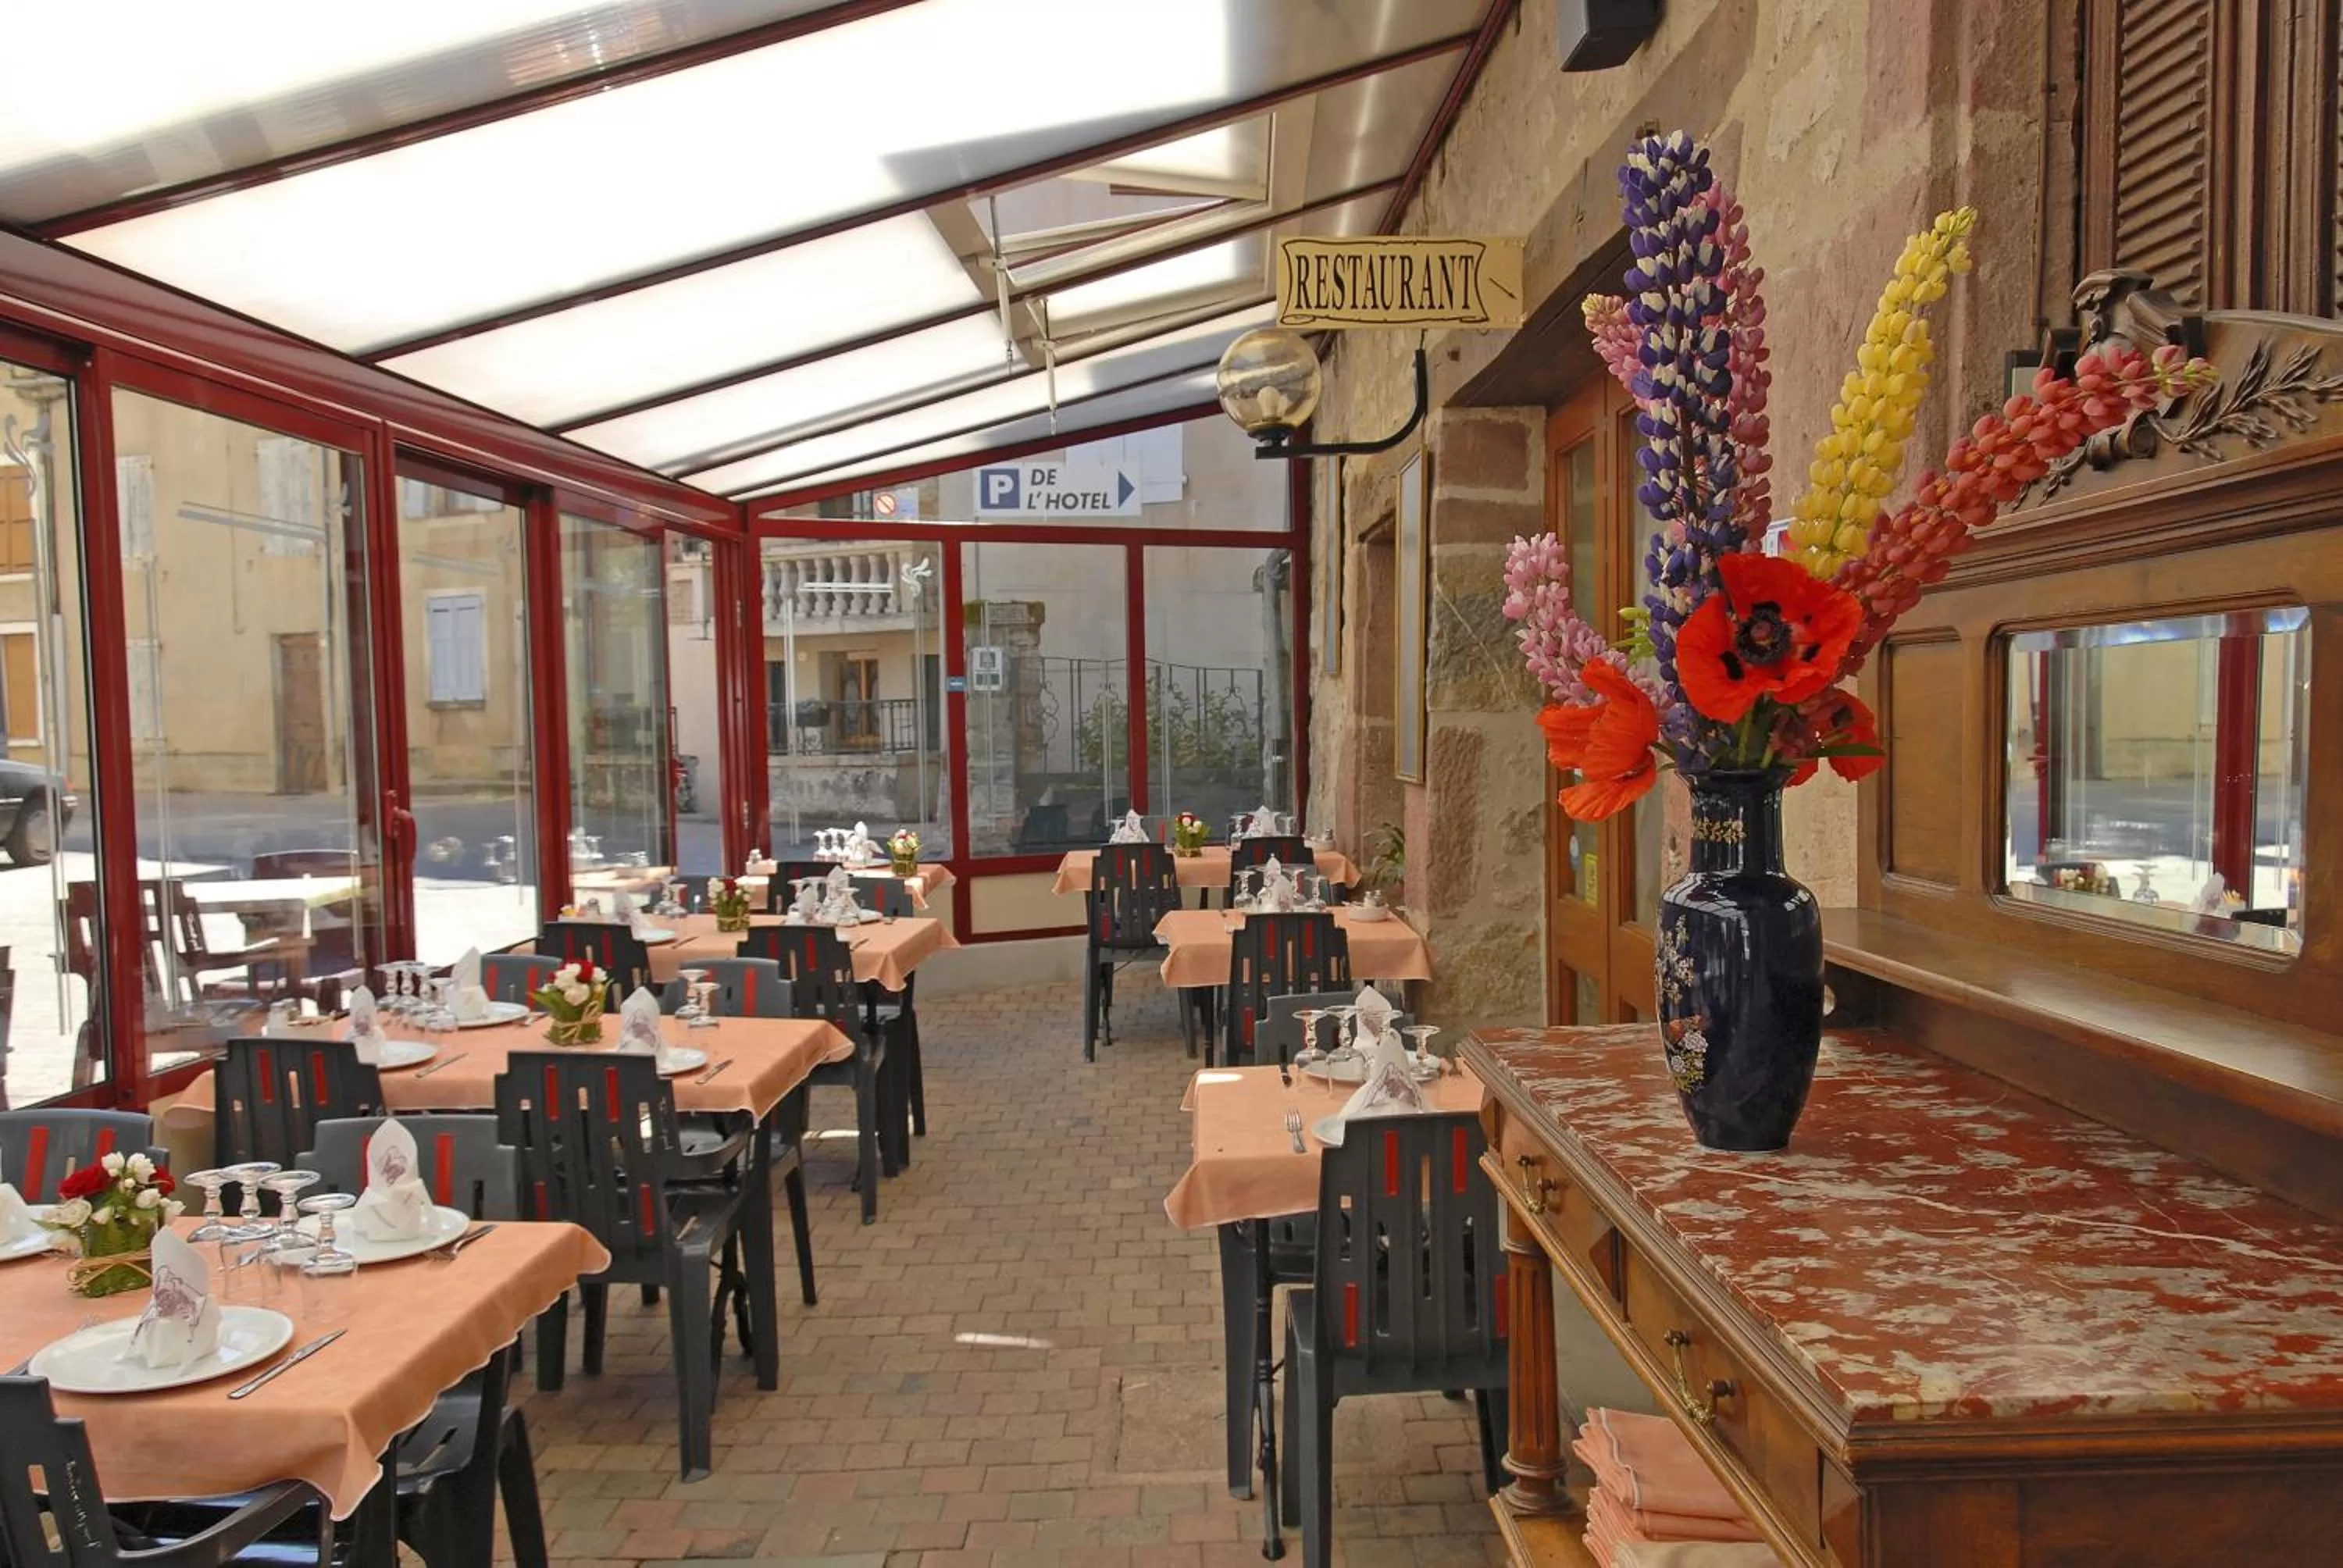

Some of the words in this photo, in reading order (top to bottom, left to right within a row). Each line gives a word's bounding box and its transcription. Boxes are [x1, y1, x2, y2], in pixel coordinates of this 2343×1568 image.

[1294, 254, 1474, 311] RESTAURANT
[1031, 469, 1057, 485] DE
[989, 474, 1014, 504] P
[1027, 492, 1111, 509] L'HOTEL
